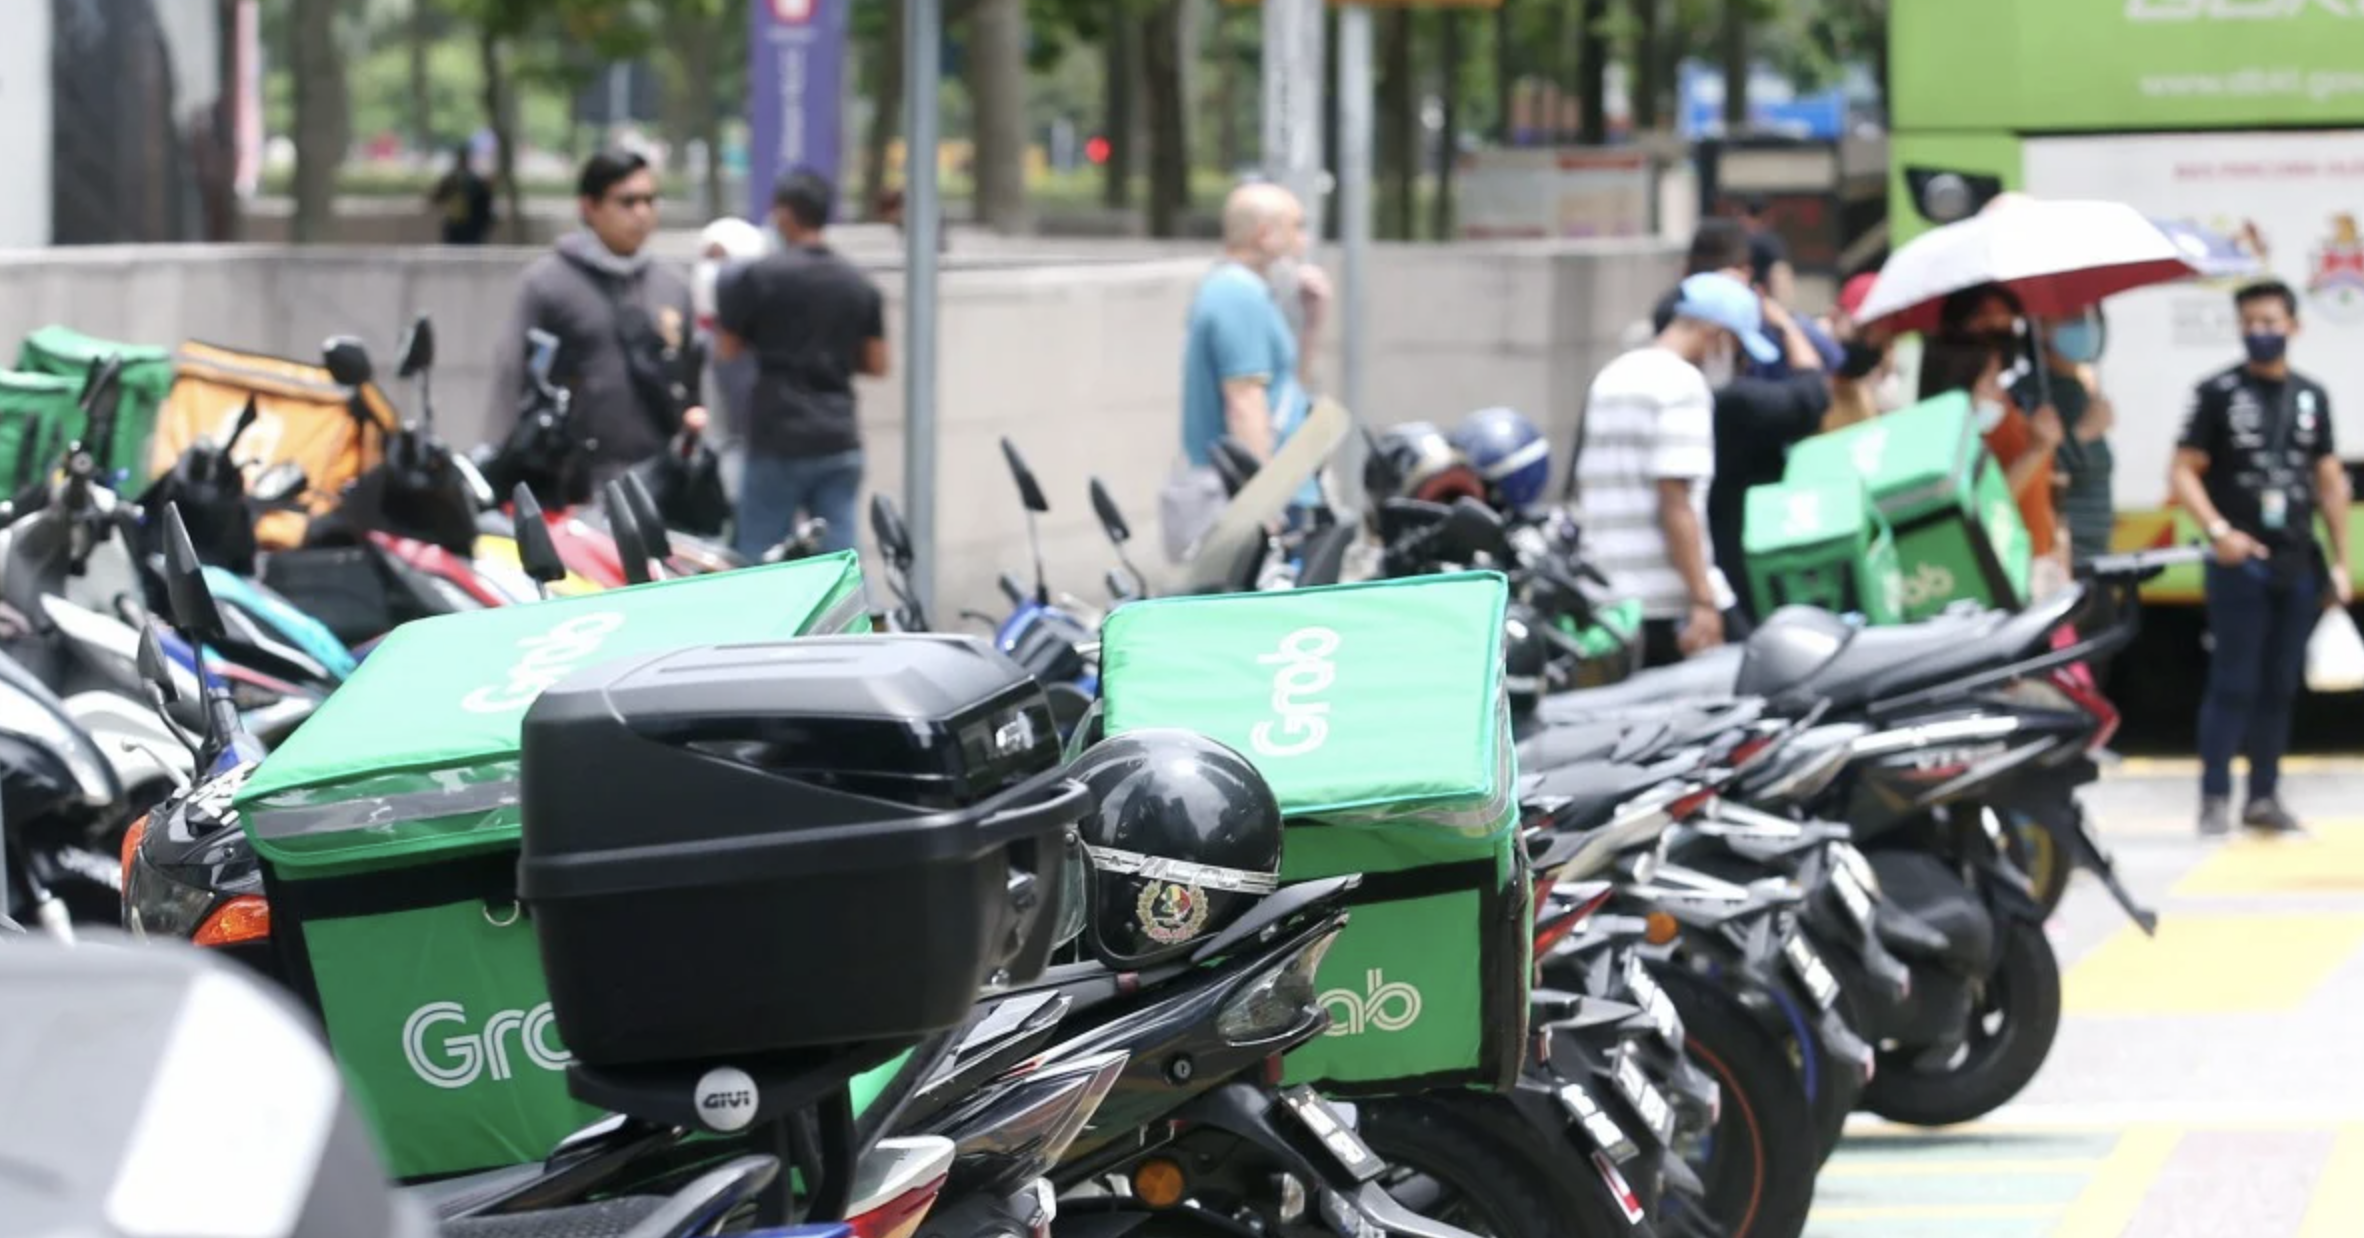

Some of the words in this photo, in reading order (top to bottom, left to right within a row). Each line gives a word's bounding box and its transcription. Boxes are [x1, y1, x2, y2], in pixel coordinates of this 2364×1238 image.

[462, 611, 626, 714] Grab
[1250, 625, 1342, 757] Grab
[402, 1000, 574, 1089] Gra
[1316, 967, 1422, 1037] ab
[702, 1090, 751, 1109] GIVI
